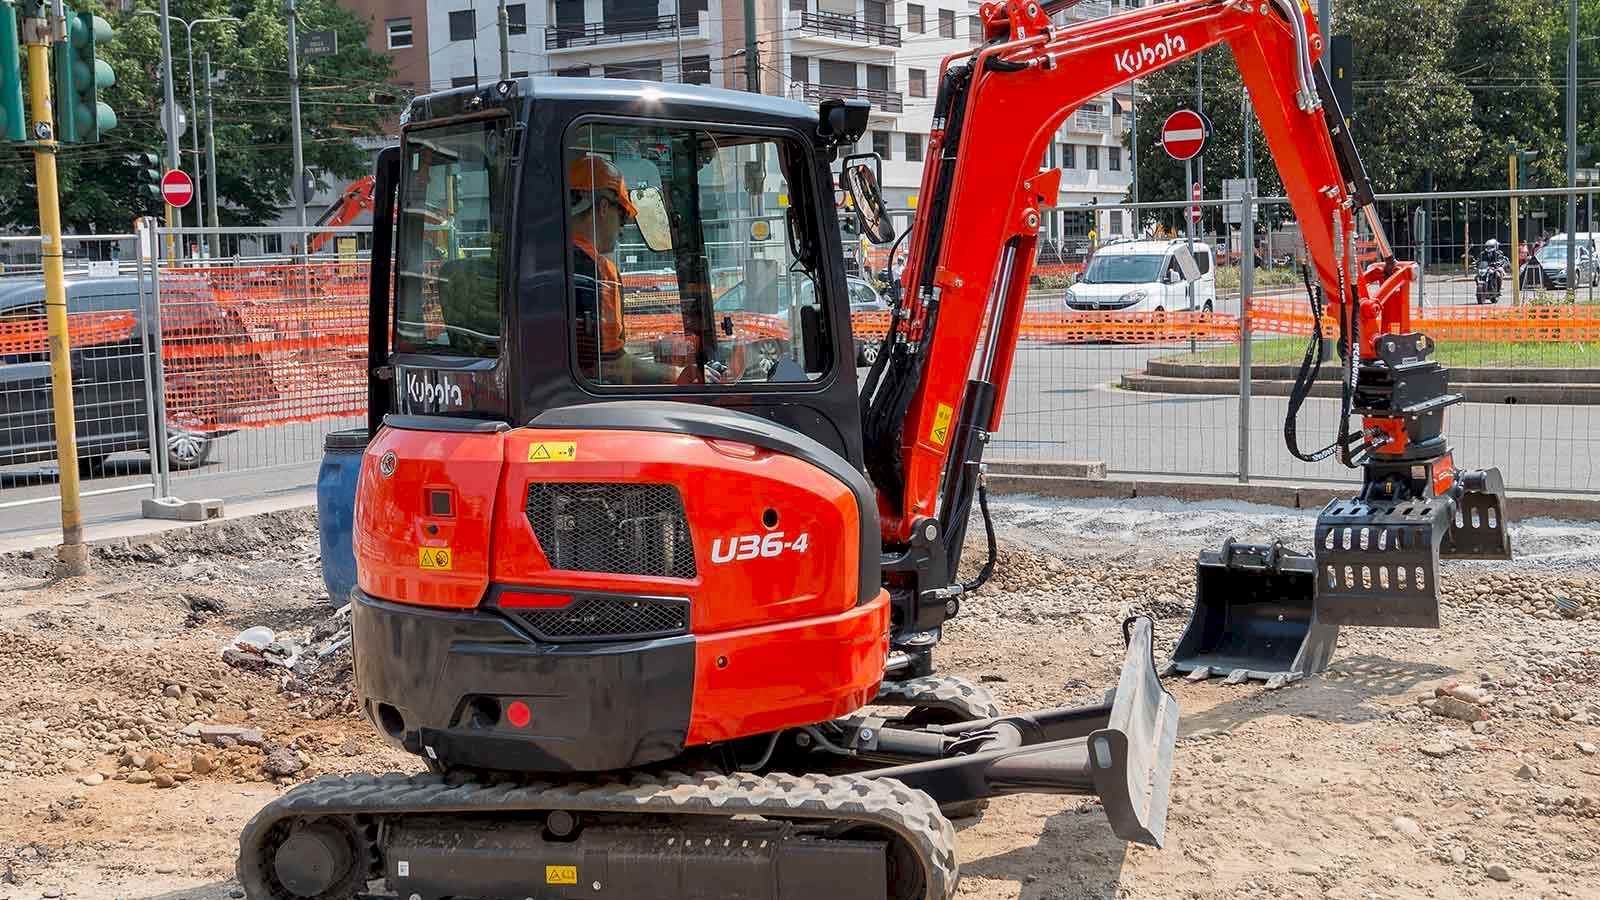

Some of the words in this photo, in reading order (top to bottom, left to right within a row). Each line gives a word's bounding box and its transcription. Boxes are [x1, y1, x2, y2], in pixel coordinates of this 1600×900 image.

[1114, 33, 1187, 74] Kubota
[406, 373, 463, 406] Kubota
[711, 531, 809, 564] U36-4
